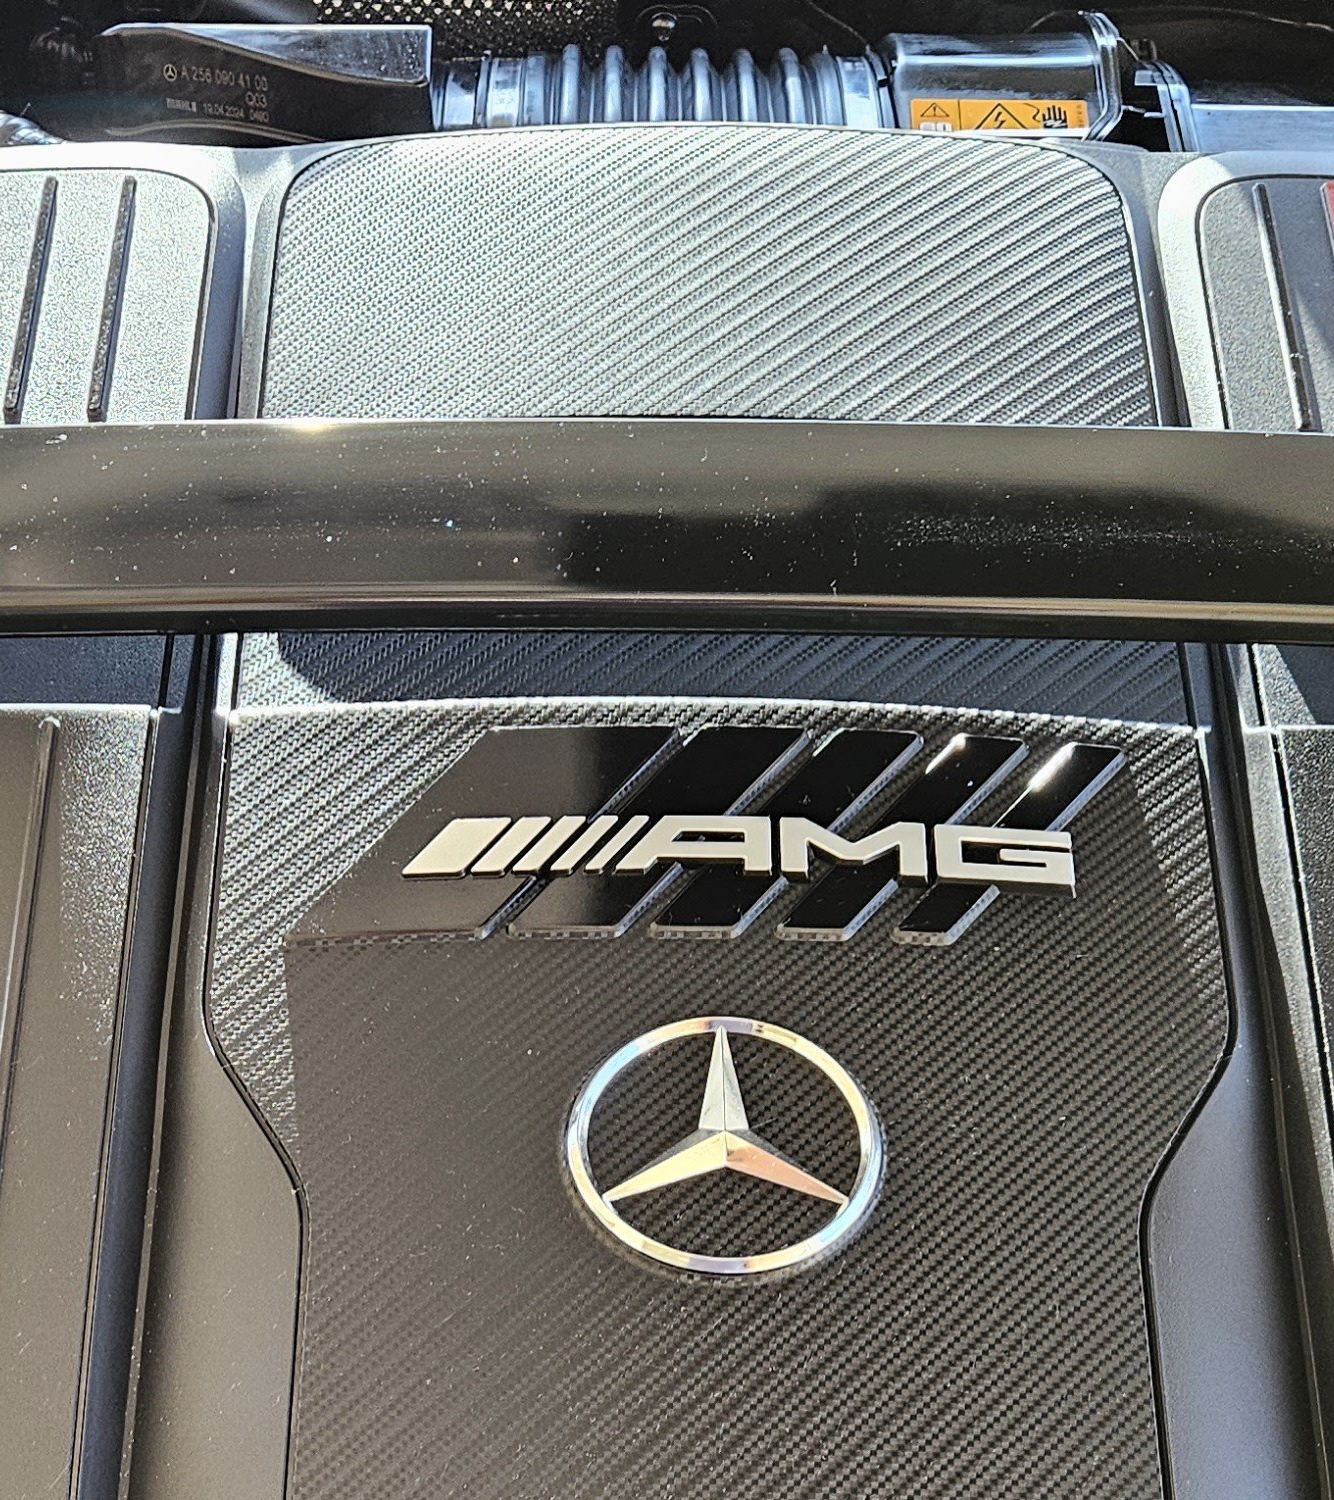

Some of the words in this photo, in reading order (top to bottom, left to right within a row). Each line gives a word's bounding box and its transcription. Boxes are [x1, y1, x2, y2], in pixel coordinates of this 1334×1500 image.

[181, 64, 190, 82] A
[192, 66, 212, 84] 256
[238, 72, 251, 90] 41
[612, 814, 1075, 893] AMG
